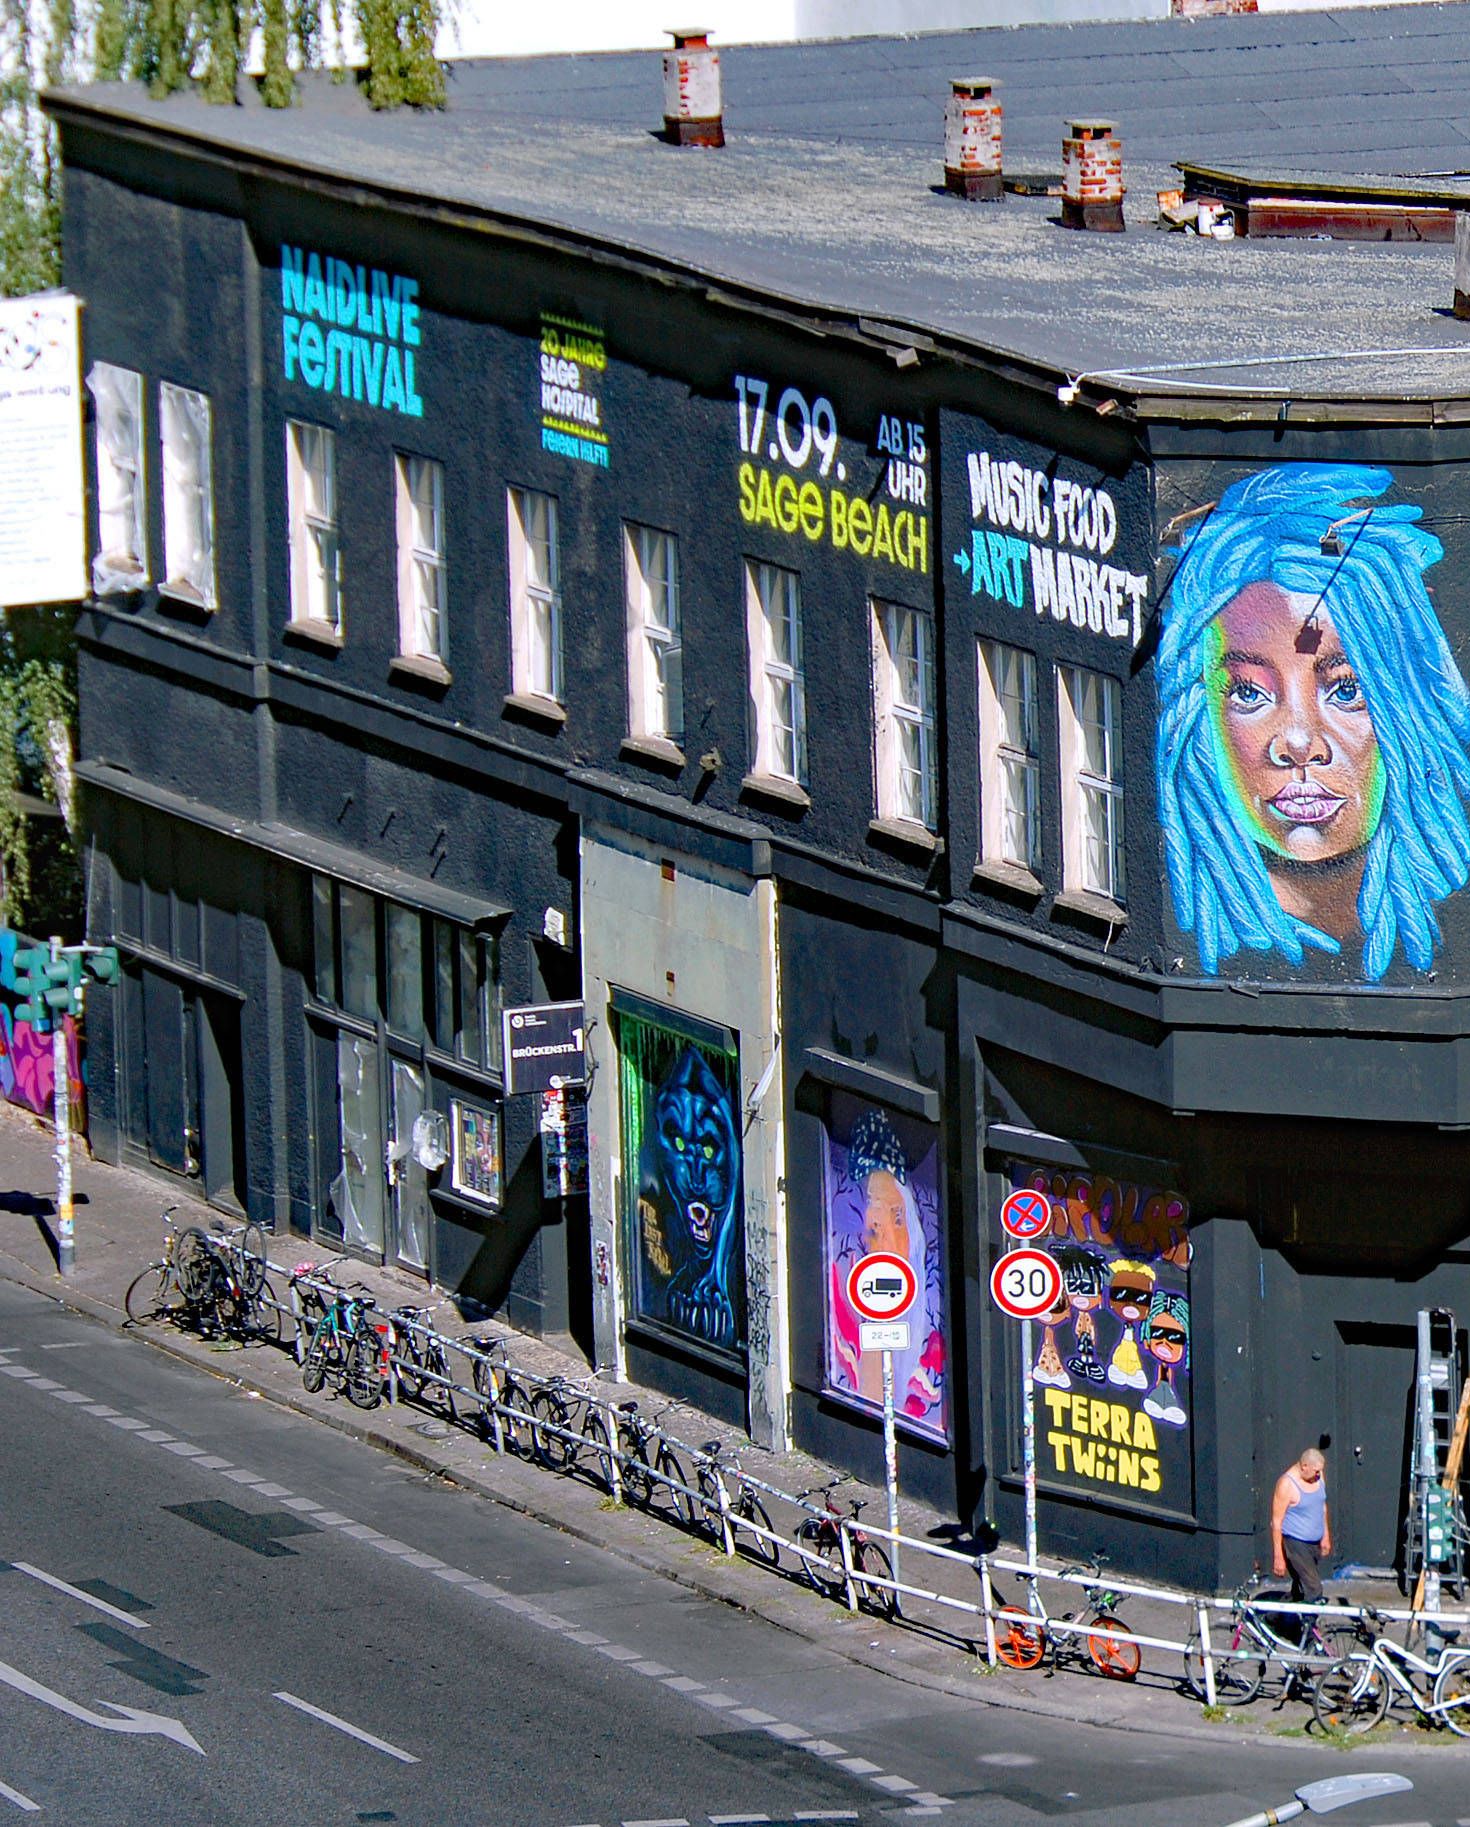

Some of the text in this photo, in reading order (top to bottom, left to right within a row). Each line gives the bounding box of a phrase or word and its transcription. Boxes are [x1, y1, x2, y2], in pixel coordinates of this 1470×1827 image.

[281, 244, 421, 346] NAIDLIVE
[540, 326, 561, 356] 20
[734, 374, 846, 481] 17.09.
[876, 414, 926, 463] AB 15
[888, 458, 926, 506] UHR
[967, 451, 1118, 555] MUSIC FOOD
[971, 530, 1149, 648] ART MARKET
[572, 1028, 583, 1051] 1
[1008, 1268, 1046, 1298] 30
[1045, 1387, 1157, 1451] TERRA
